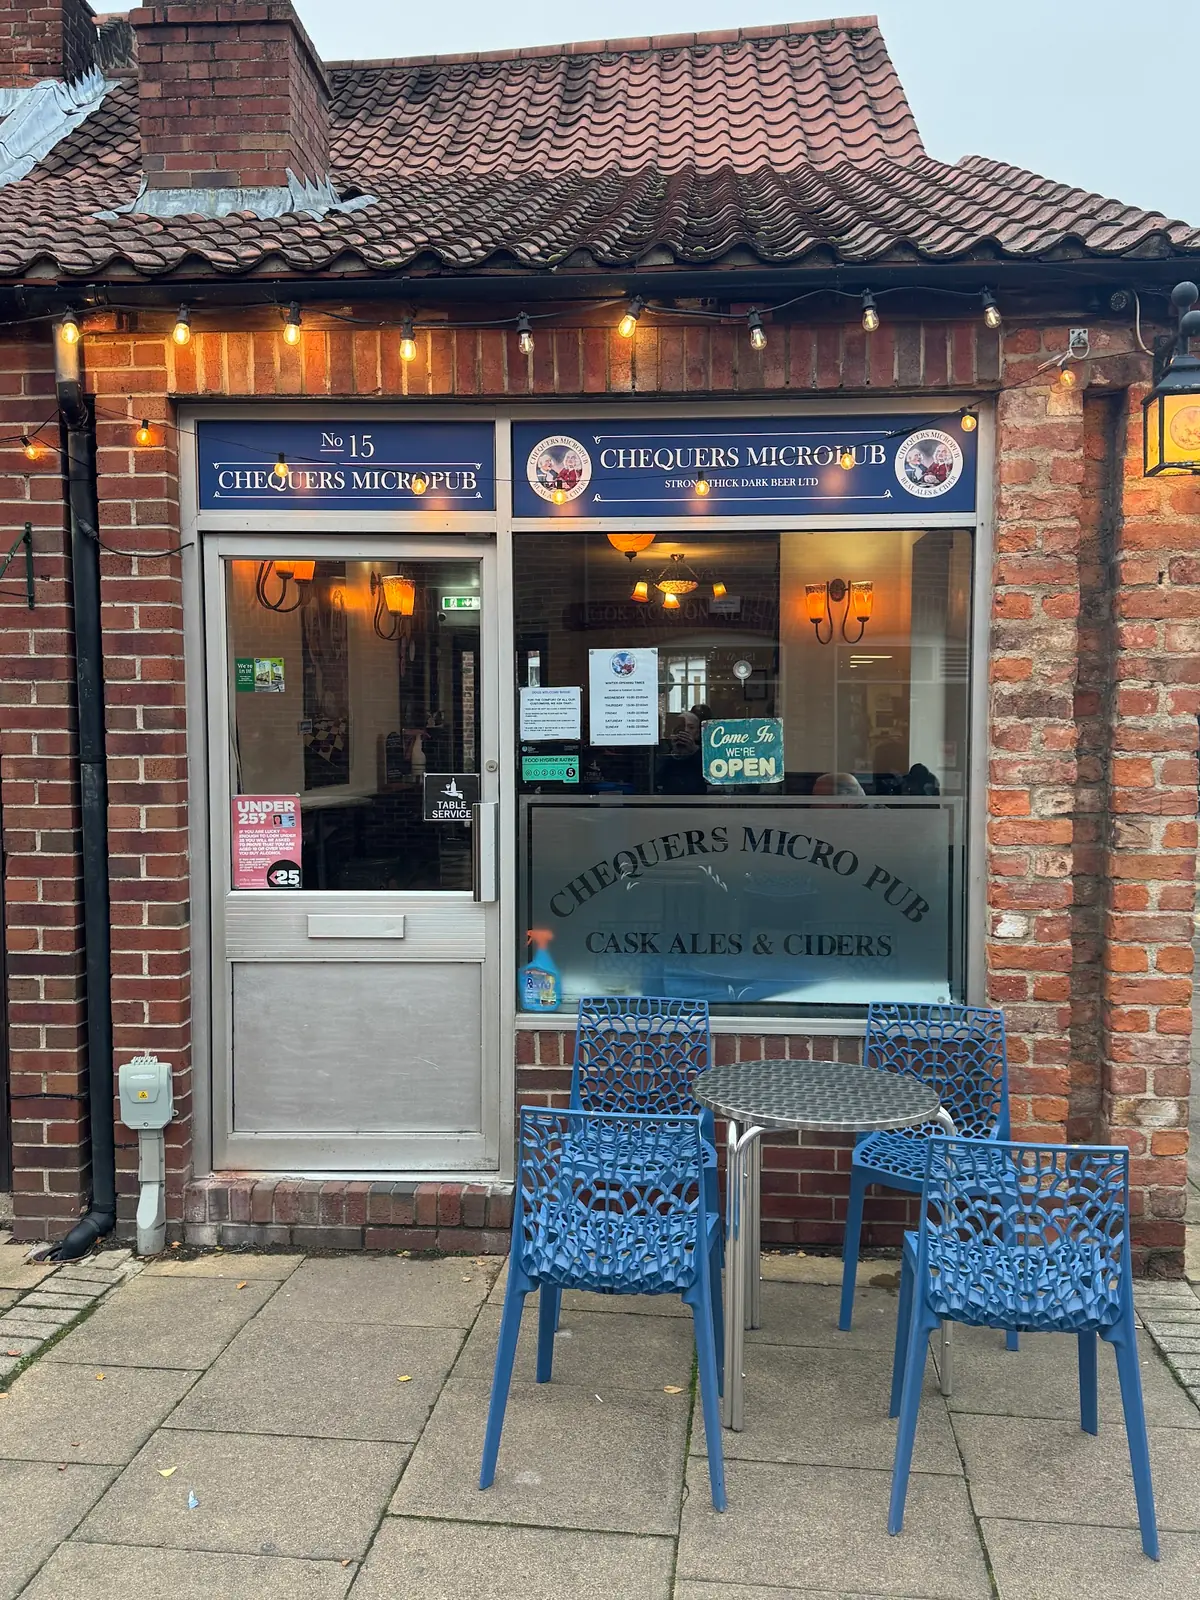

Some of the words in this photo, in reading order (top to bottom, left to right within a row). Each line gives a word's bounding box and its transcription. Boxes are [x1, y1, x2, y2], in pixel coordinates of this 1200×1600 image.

[321, 432, 344, 447] No
[350, 434, 375, 458] 15
[898, 433, 930, 460] CHEQUERS
[931, 432, 960, 459] MICROPUB
[600, 446, 739, 471] CHEQUERS
[218, 470, 345, 492] CHEQUERS
[664, 479, 702, 488] STRON
[708, 478, 739, 488] THICK
[741, 477, 768, 487] DARK
[771, 477, 796, 486] BEER
[798, 477, 819, 486] LTD
[710, 726, 749, 748] Come
[753, 725, 776, 743] In
[726, 747, 756, 757] WE'RE
[567, 768, 574, 777] 5
[710, 757, 776, 778] OPEN
[237, 801, 295, 812] UNDER
[432, 809, 472, 818] SERVICE
[436, 801, 467, 809] TABLE
[238, 813, 267, 825] 25?
[549, 826, 730, 919] CHEQUERS
[740, 826, 859, 878] MICRO
[862, 864, 930, 924] PUB
[585, 931, 661, 955] CASK
[668, 933, 743, 956] ALES
[752, 932, 775, 955] &
[784, 933, 893, 958] CIDERS
